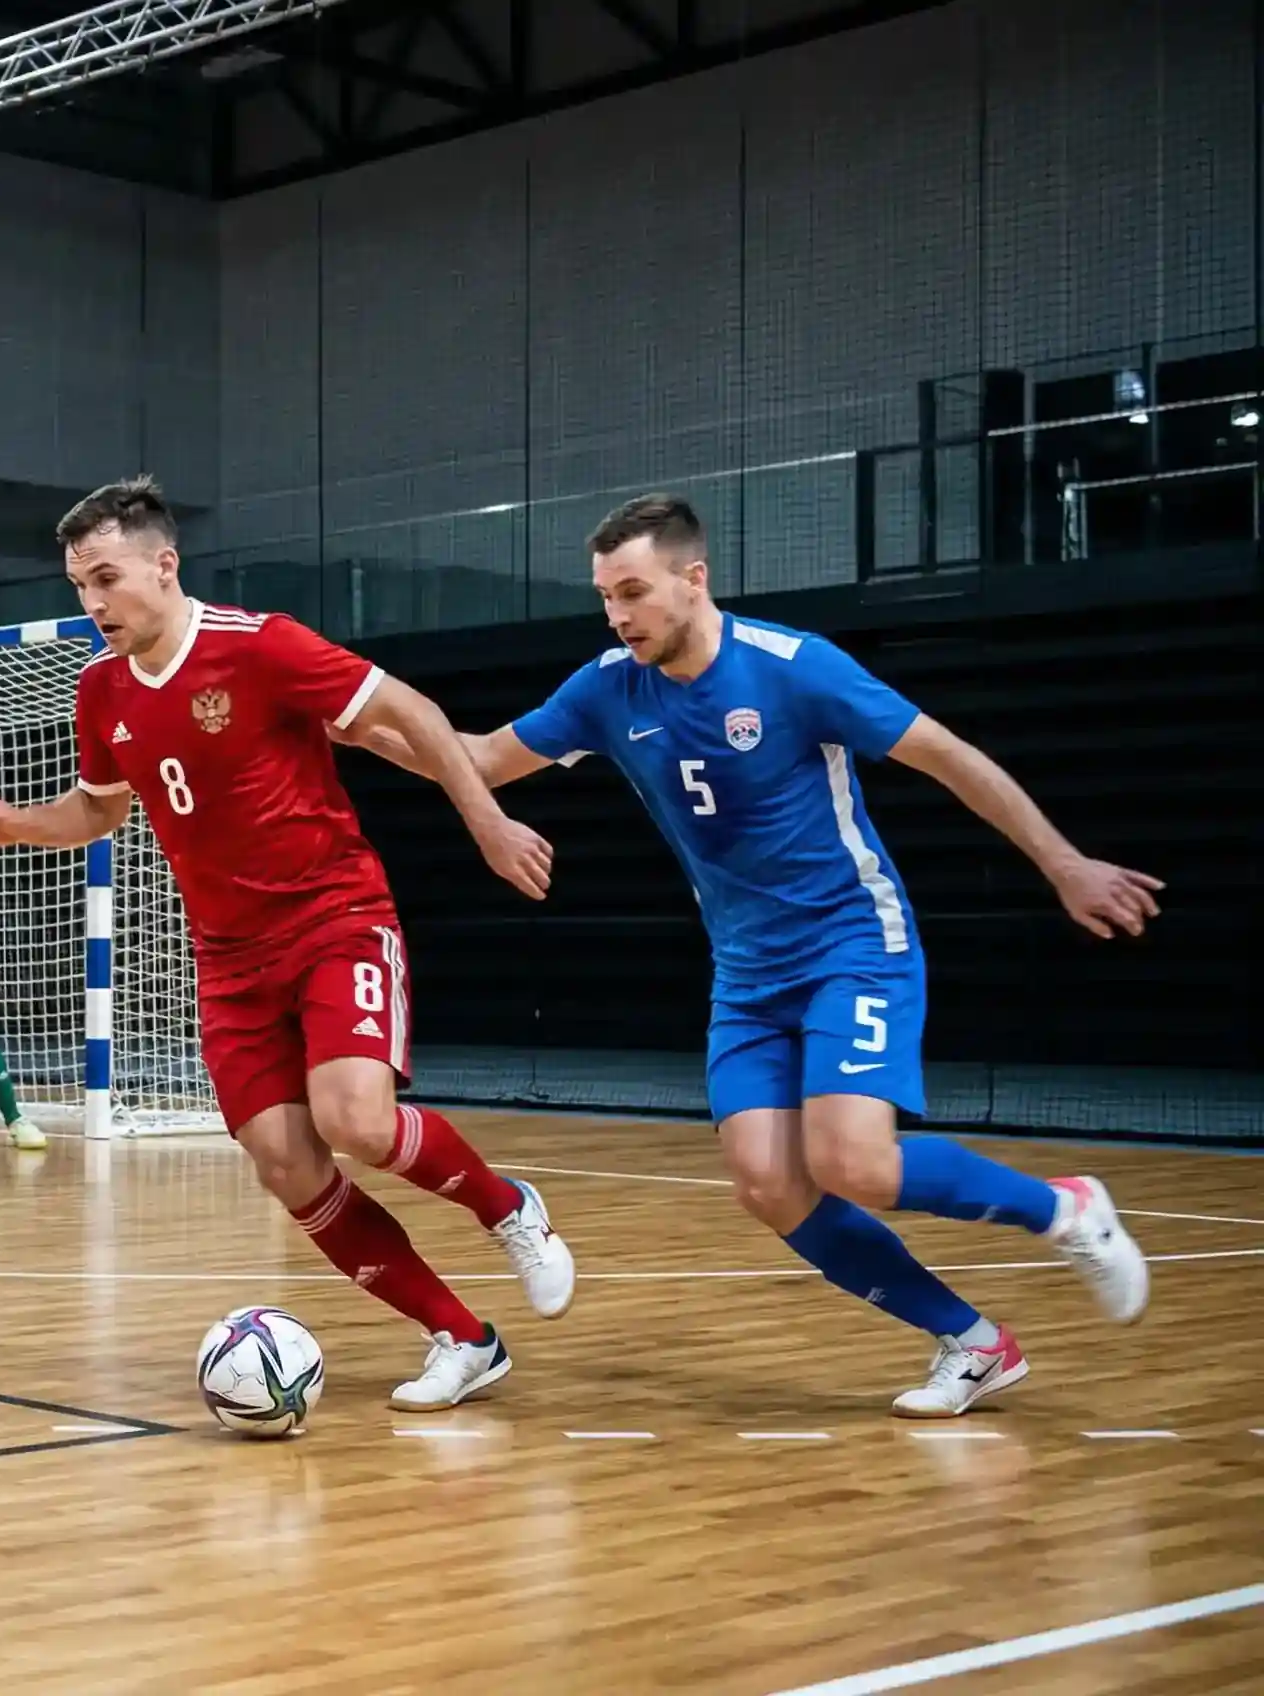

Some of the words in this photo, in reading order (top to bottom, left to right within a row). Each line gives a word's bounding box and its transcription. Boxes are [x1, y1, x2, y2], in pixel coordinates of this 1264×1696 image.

[159, 757, 194, 815] 8
[679, 760, 716, 815] 5
[353, 962, 384, 1012] 8
[852, 995, 889, 1052] 5
